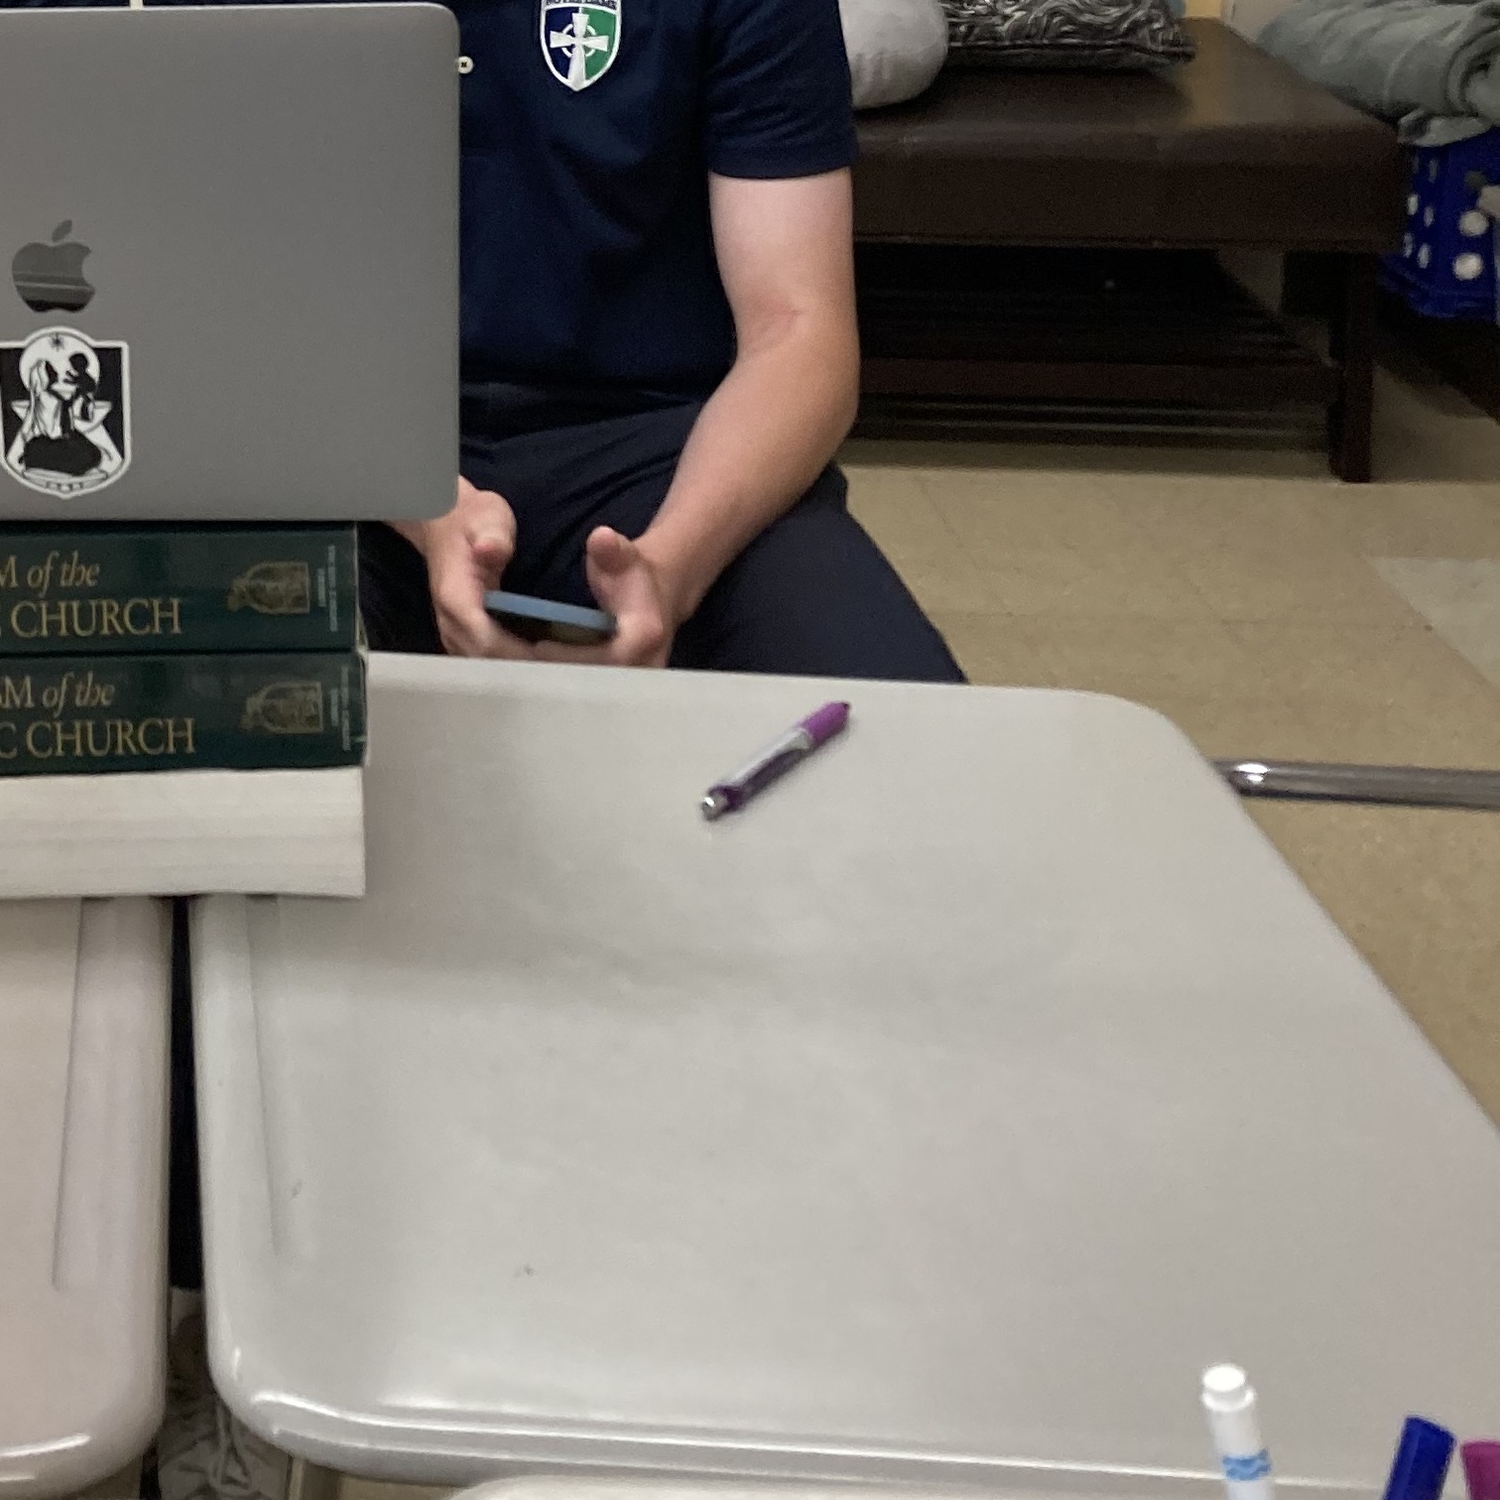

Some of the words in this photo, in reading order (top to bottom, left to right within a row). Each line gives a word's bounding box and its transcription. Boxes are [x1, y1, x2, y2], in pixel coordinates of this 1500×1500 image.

[26, 550, 59, 598] of
[60, 550, 100, 587] the
[11, 597, 182, 638] CHURCH
[42, 671, 75, 718] of
[75, 671, 116, 707] the
[26, 717, 196, 759] CHURCH
